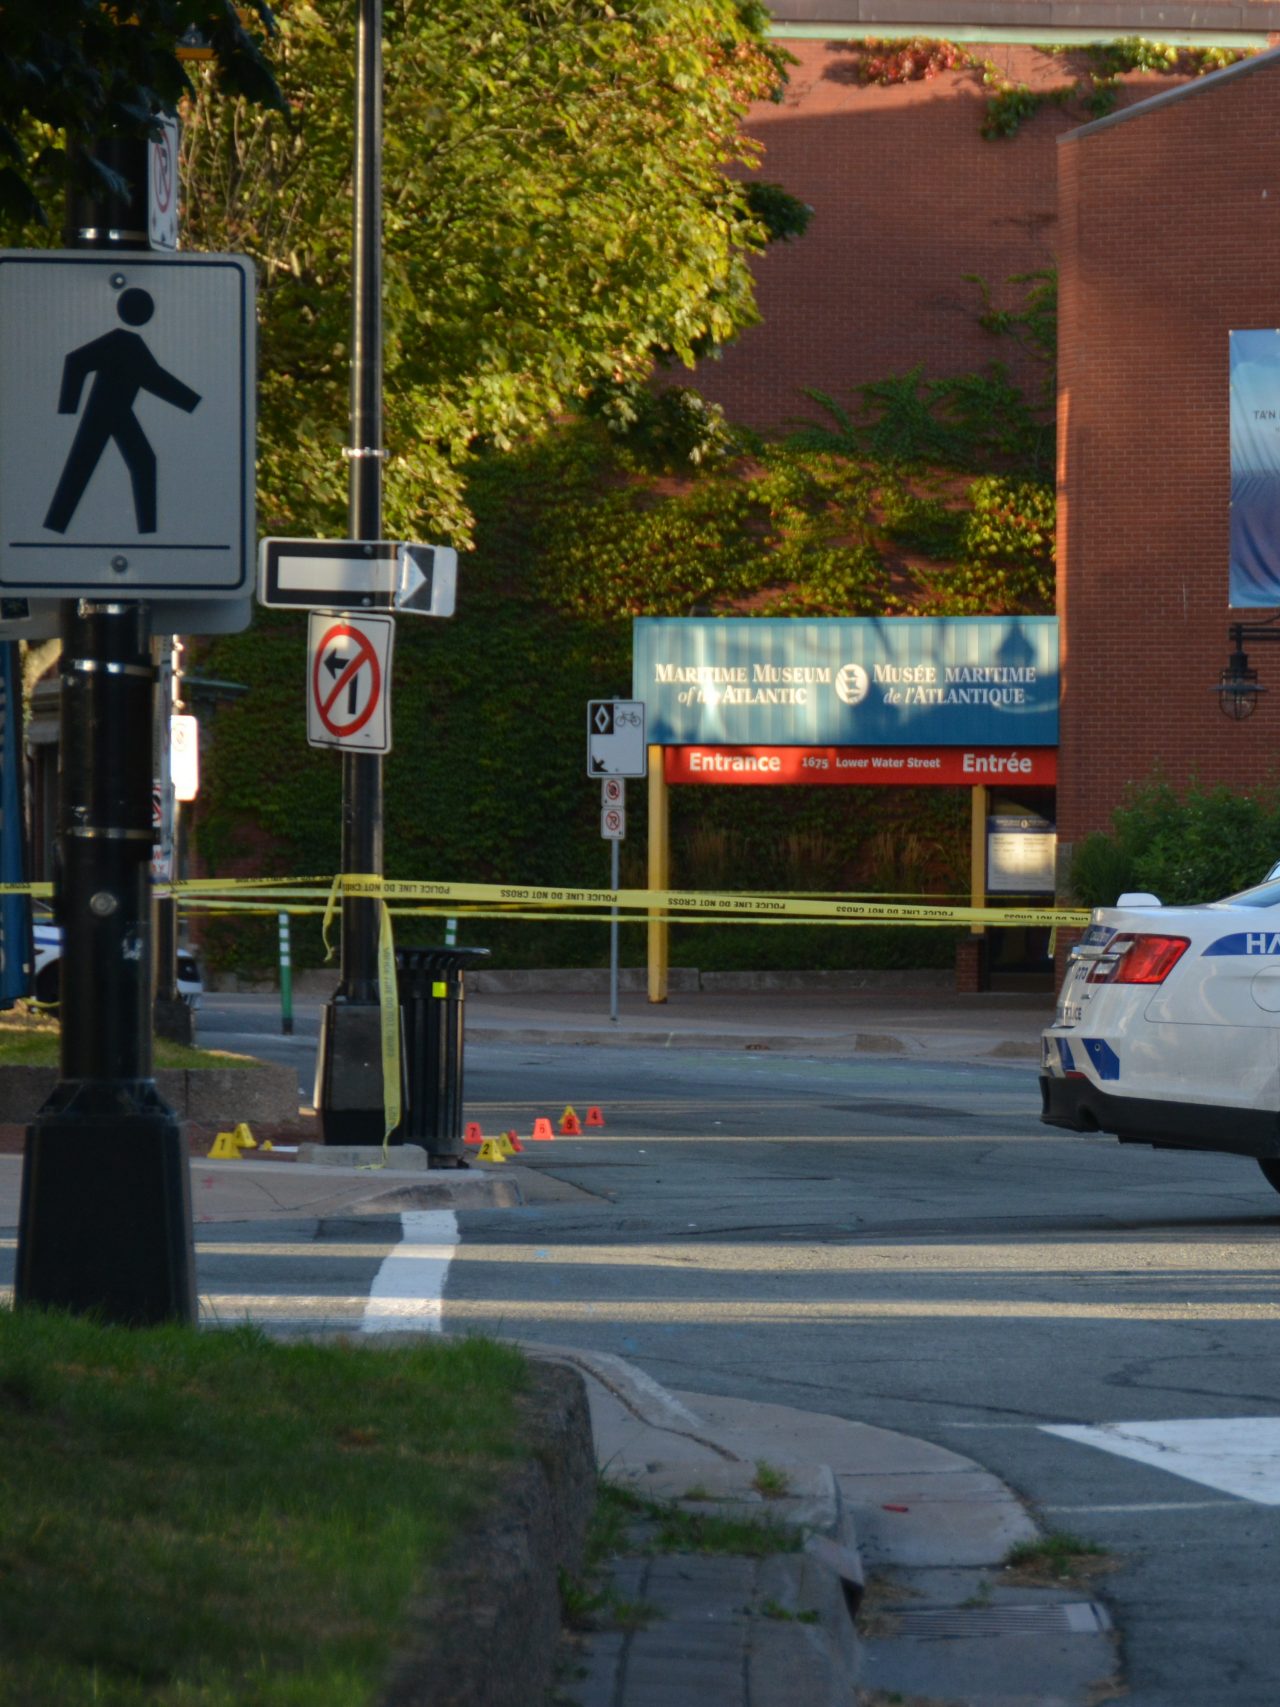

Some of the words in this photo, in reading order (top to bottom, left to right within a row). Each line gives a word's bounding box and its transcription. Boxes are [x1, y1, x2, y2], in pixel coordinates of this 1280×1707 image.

[1254, 410, 1275, 420] TA'N
[655, 664, 747, 683] MARITIME
[752, 664, 832, 683] MUSEUM
[872, 664, 936, 683] MUSÉE
[944, 666, 1036, 683] MARITIME
[677, 686, 696, 707] of
[723, 685, 807, 705] ATLANTIC
[883, 688, 901, 704] de
[689, 753, 781, 771] Entrance
[802, 757, 829, 769] 1675
[835, 757, 869, 769] Lower
[871, 757, 904, 769] Water
[907, 757, 941, 769] Street
[962, 752, 1032, 773] Entrée
[364, 883, 381, 892] NOT
[384, 883, 395, 893] DO
[398, 884, 417, 893] LINE
[420, 885, 450, 895] POLICE
[500, 889, 529, 899] CROSS
[532, 891, 548, 900] NOT
[551, 892, 563, 901] DO
[566, 893, 585, 902] LINE
[588, 893, 618, 903] POLICE
[667, 898, 696, 906] CROSS
[699, 899, 716, 907] NOT
[718, 900, 731, 908] DO
[733, 901, 752, 909] LINE
[755, 902, 786, 910] POLICE
